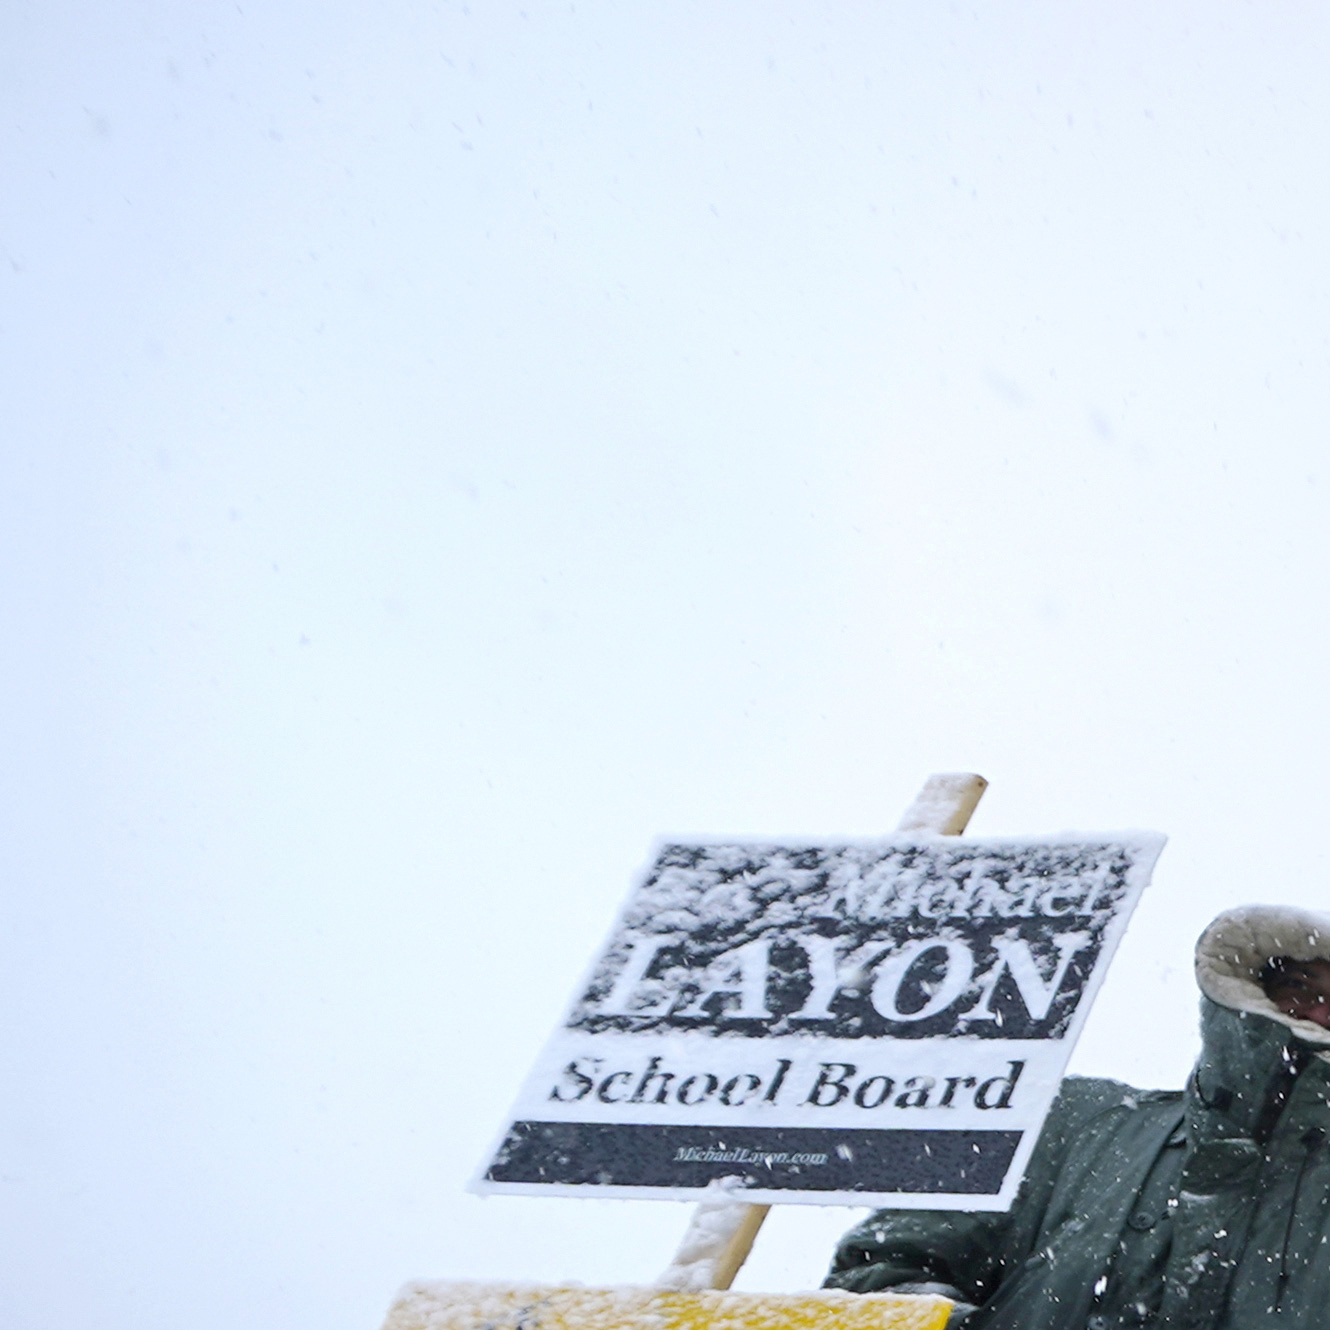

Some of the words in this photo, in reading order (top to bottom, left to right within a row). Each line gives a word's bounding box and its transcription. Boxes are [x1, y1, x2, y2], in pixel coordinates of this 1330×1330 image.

[591, 930, 1093, 1023] LAYON
[549, 1055, 793, 1109] School
[796, 1060, 1028, 1111] Board
[673, 1145, 829, 1166] MichaelLayon.com
